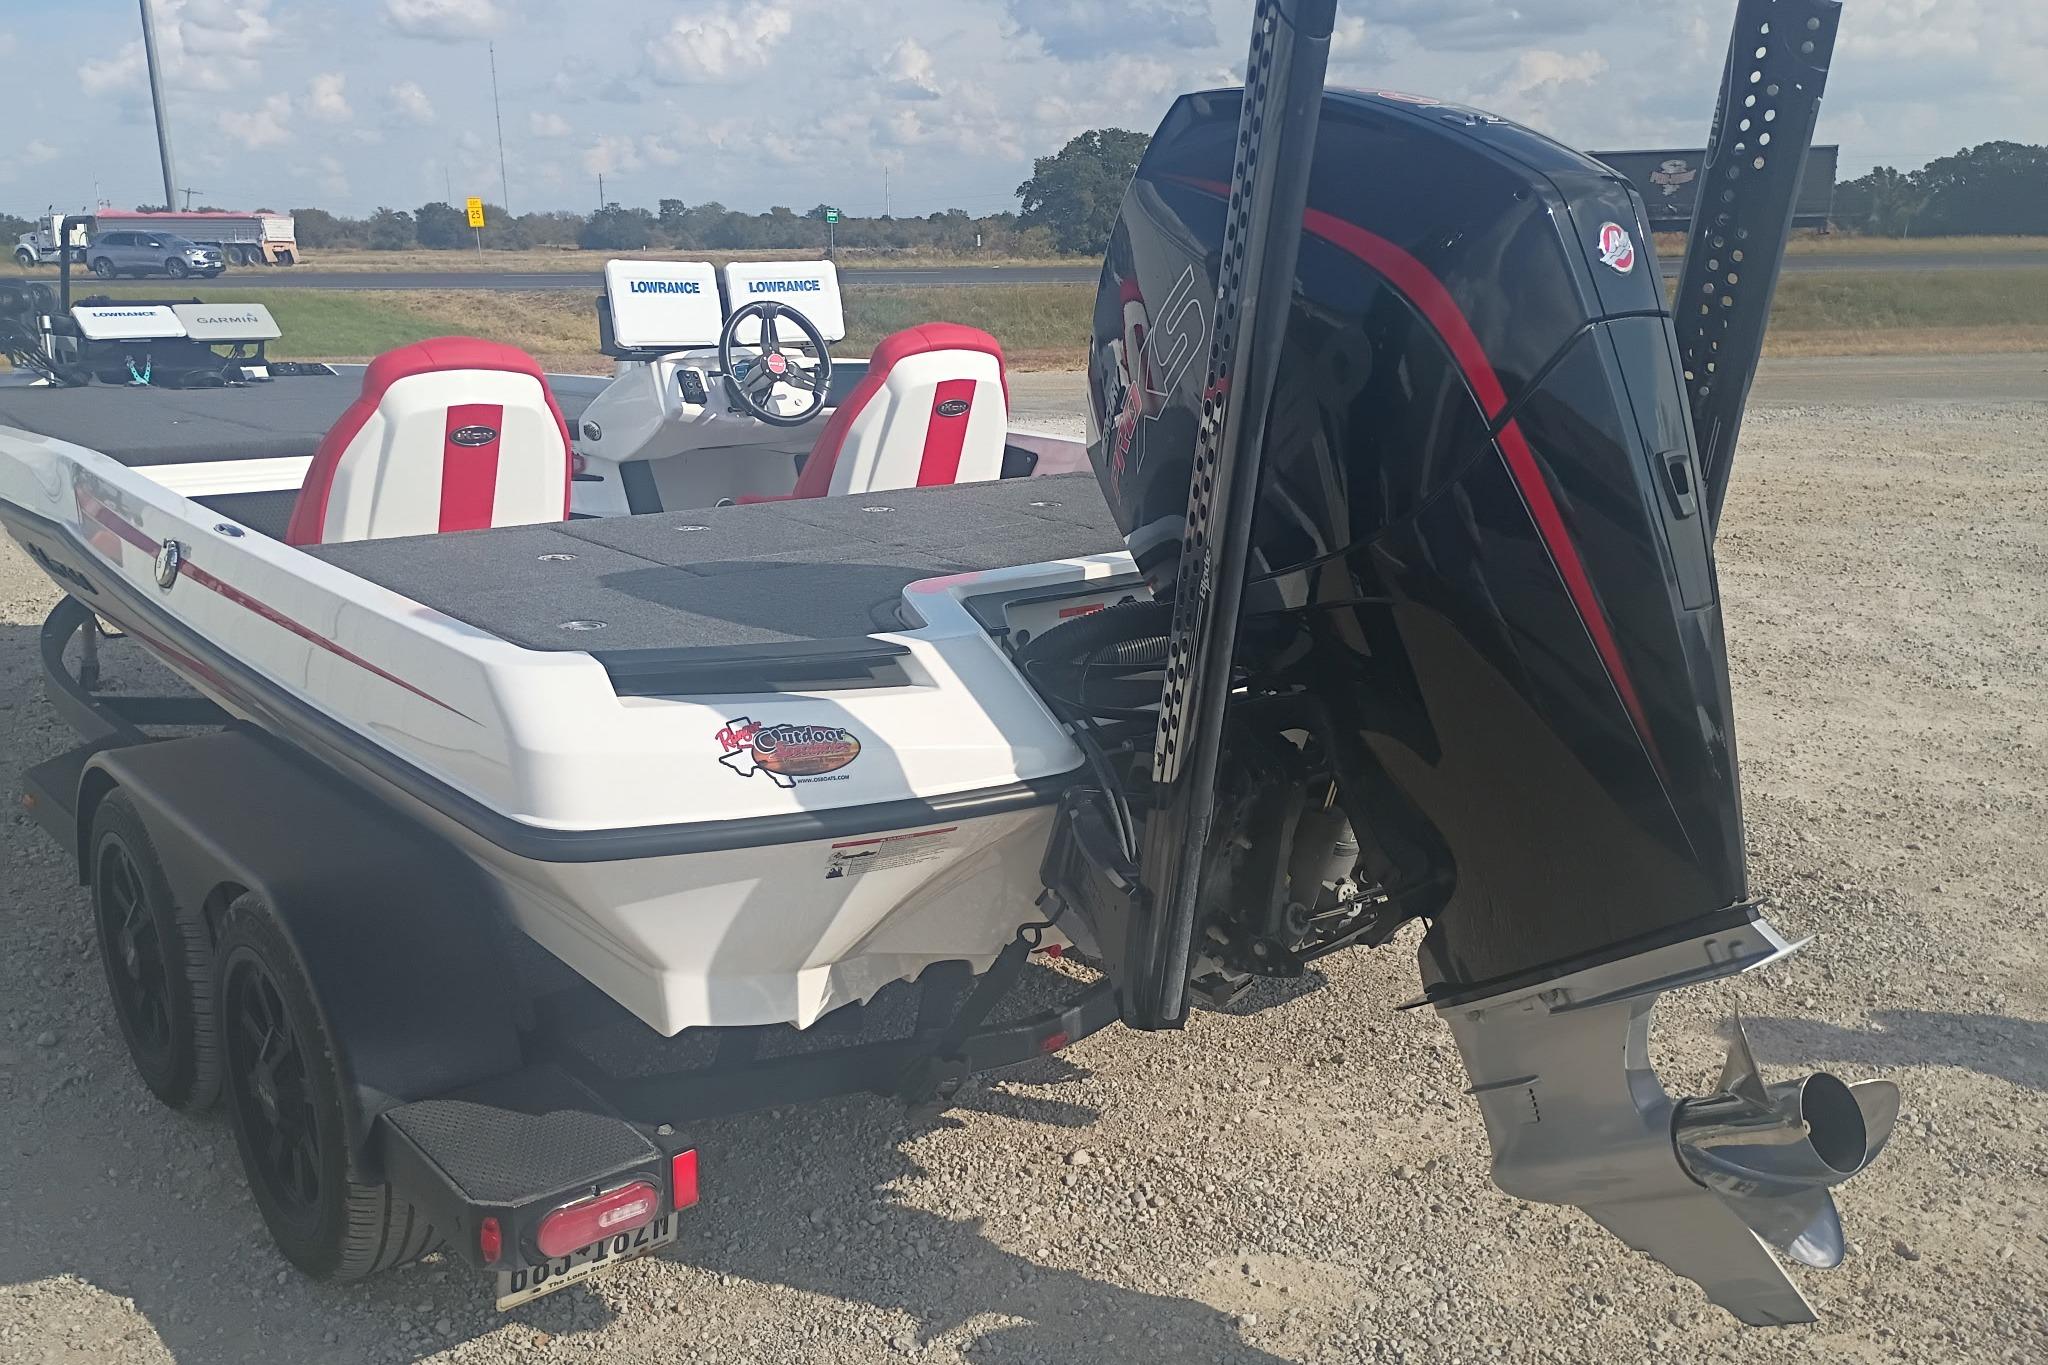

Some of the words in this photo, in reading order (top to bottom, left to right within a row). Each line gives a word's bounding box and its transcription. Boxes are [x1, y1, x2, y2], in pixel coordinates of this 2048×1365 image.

[471, 210, 481, 219] 25
[630, 281, 701, 294] LOWRANCE
[748, 280, 821, 293] LOWRANCE
[196, 315, 259, 325] GARMIN
[1199, 548, 1212, 599] Blade
[715, 721, 762, 752] Ranger
[754, 726, 846, 754] Outdoor
[548, 1279, 566, 1289] The
[567, 1270, 588, 1282] Lone
[590, 1263, 609, 1273] Star
[611, 1253, 633, 1264] State
